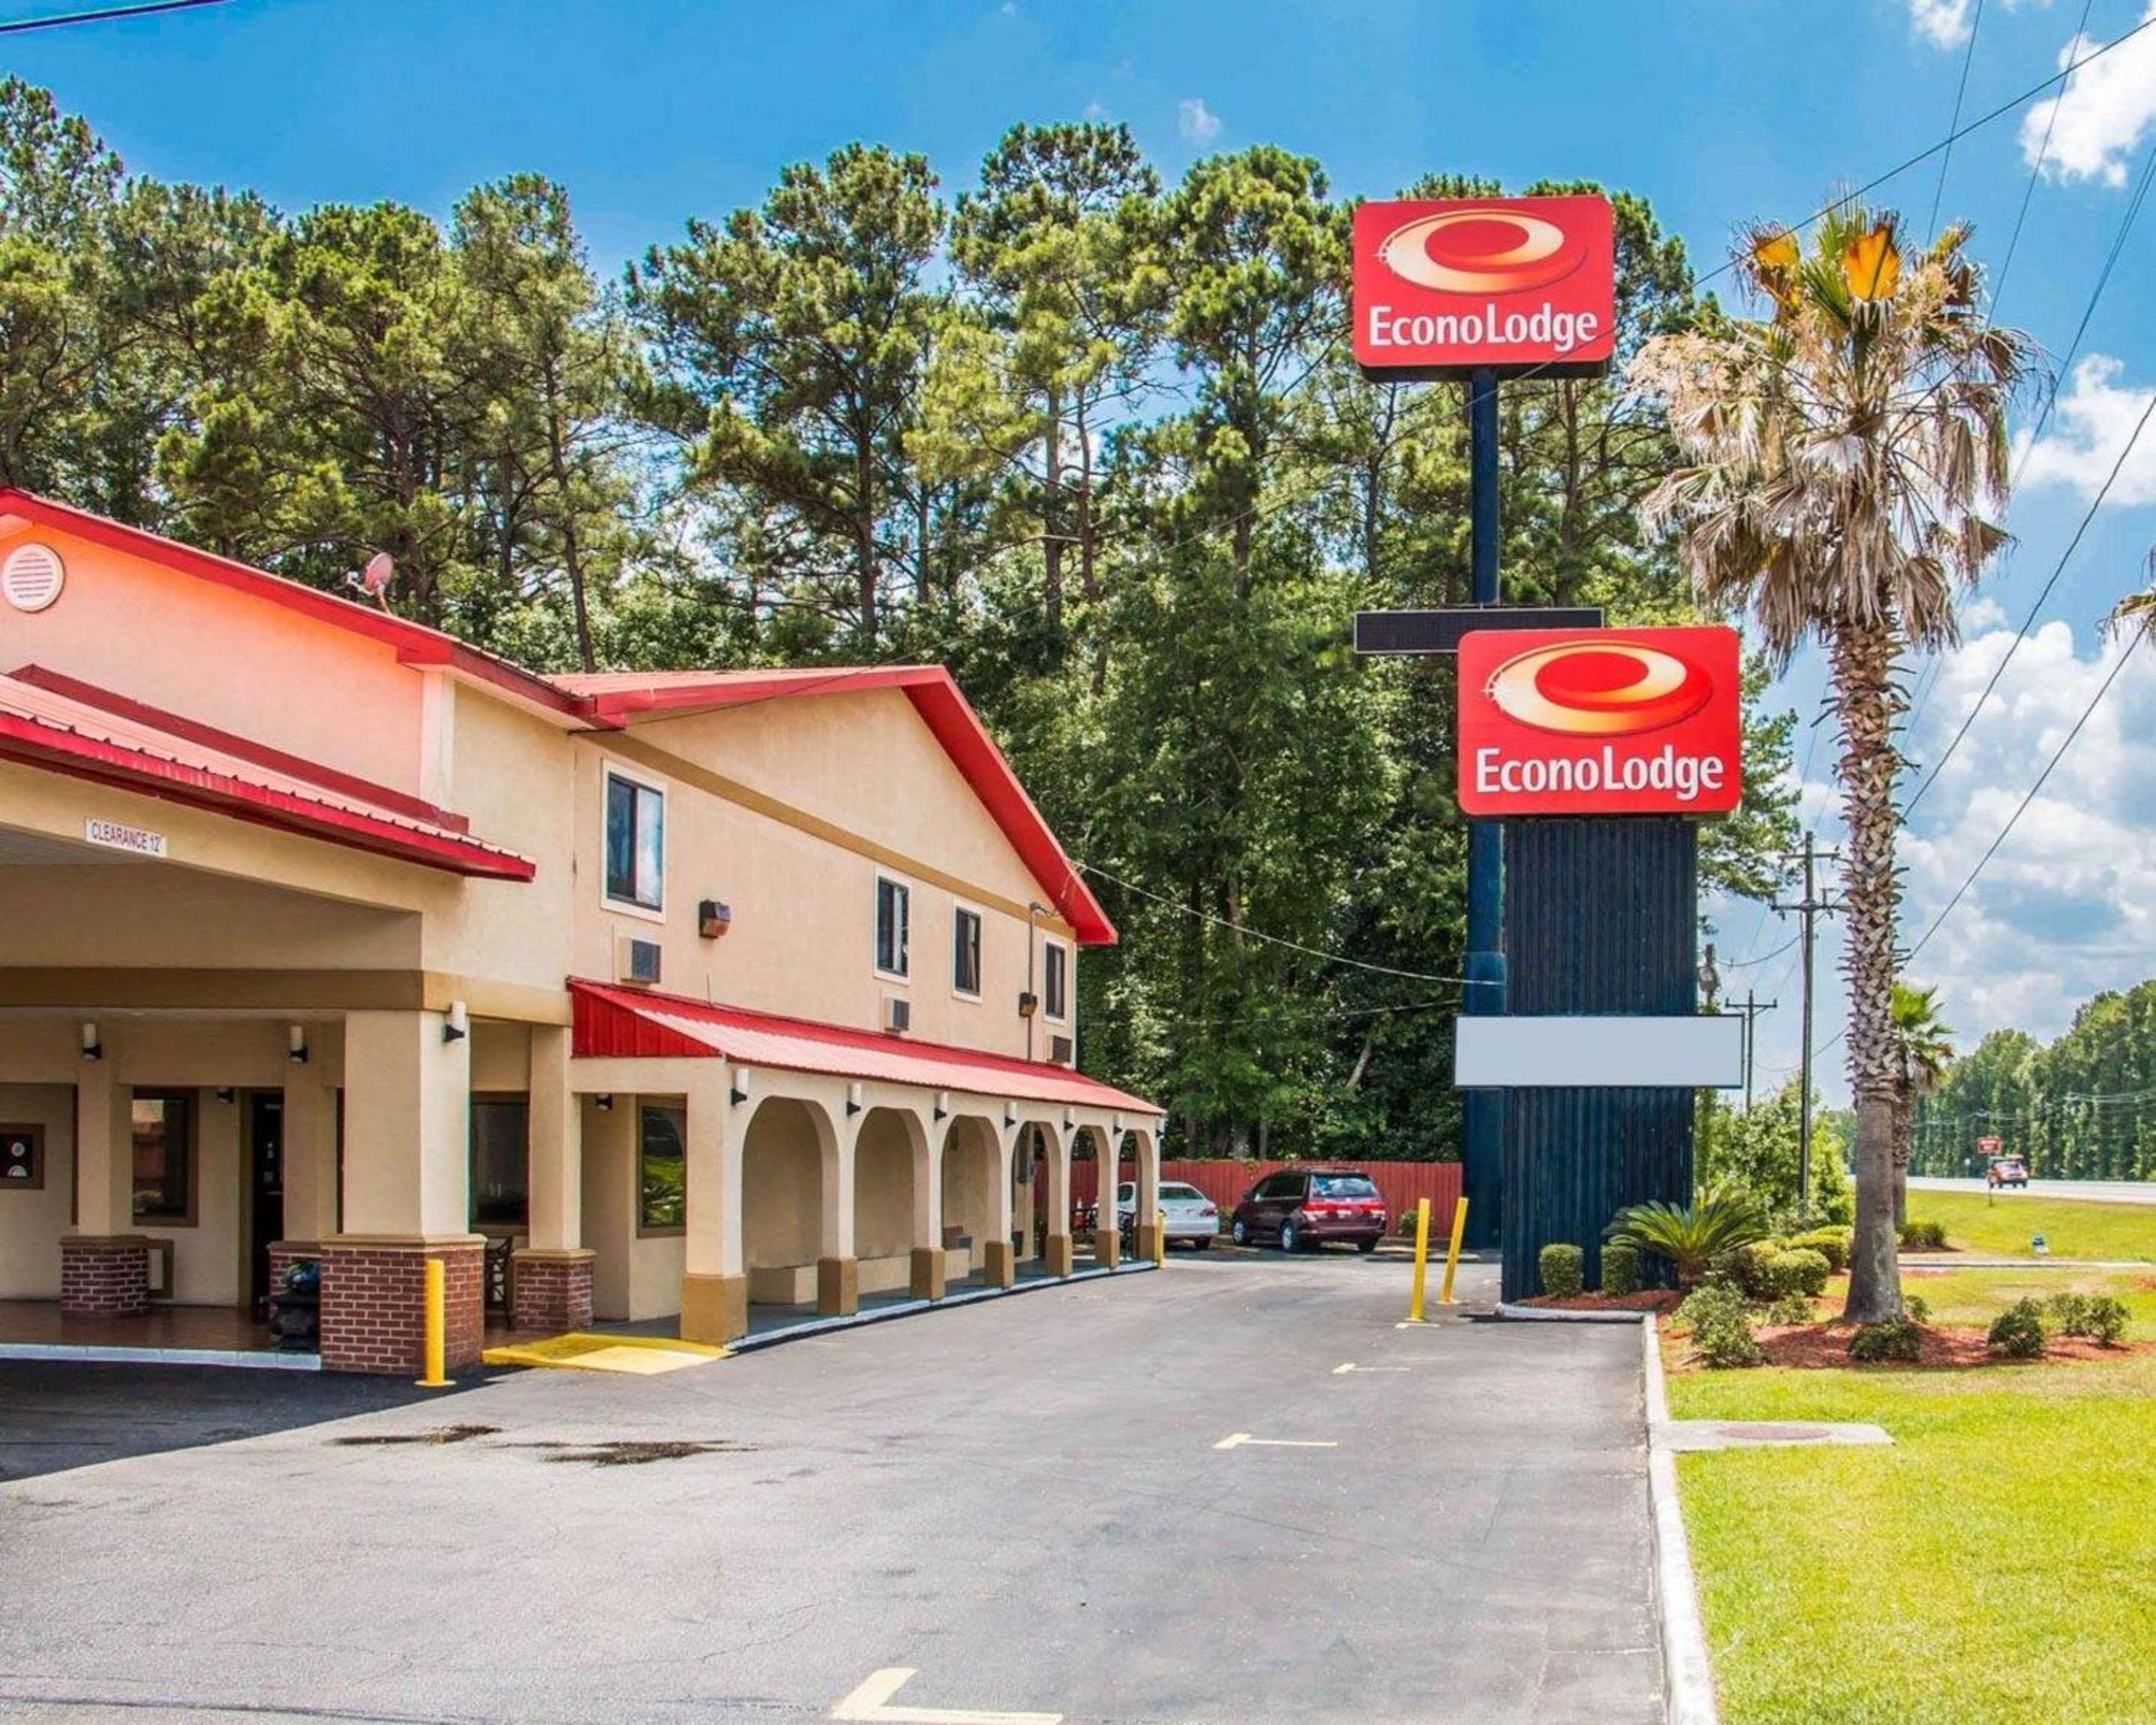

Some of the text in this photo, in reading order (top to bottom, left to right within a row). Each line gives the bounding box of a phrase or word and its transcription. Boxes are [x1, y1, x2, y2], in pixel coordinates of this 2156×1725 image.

[1368, 302, 1598, 352] EconoLodge
[1476, 744, 1723, 800] EconoLodge
[91, 822, 147, 850] CLEARANCE
